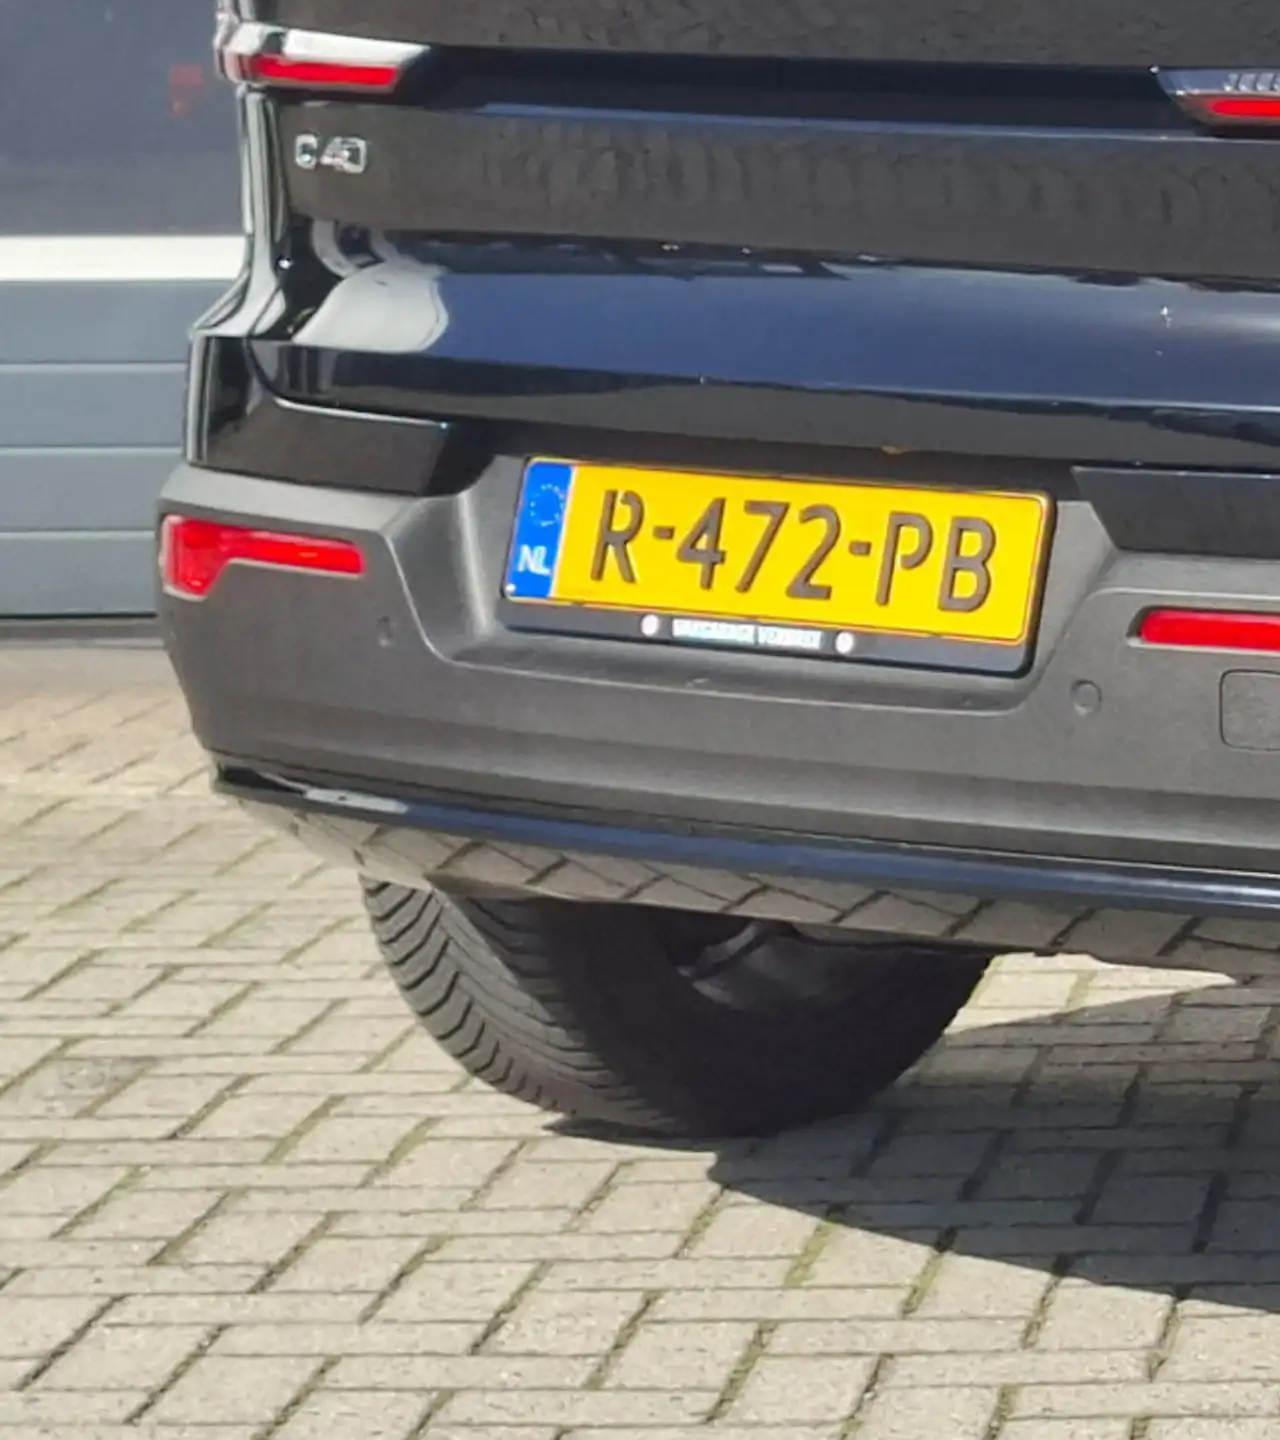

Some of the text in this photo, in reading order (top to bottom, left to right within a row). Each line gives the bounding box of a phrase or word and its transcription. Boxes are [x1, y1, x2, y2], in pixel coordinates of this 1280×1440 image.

[295, 133, 367, 174] C40
[518, 544, 551, 577] NL
[589, 489, 998, 614] R-472-PB
